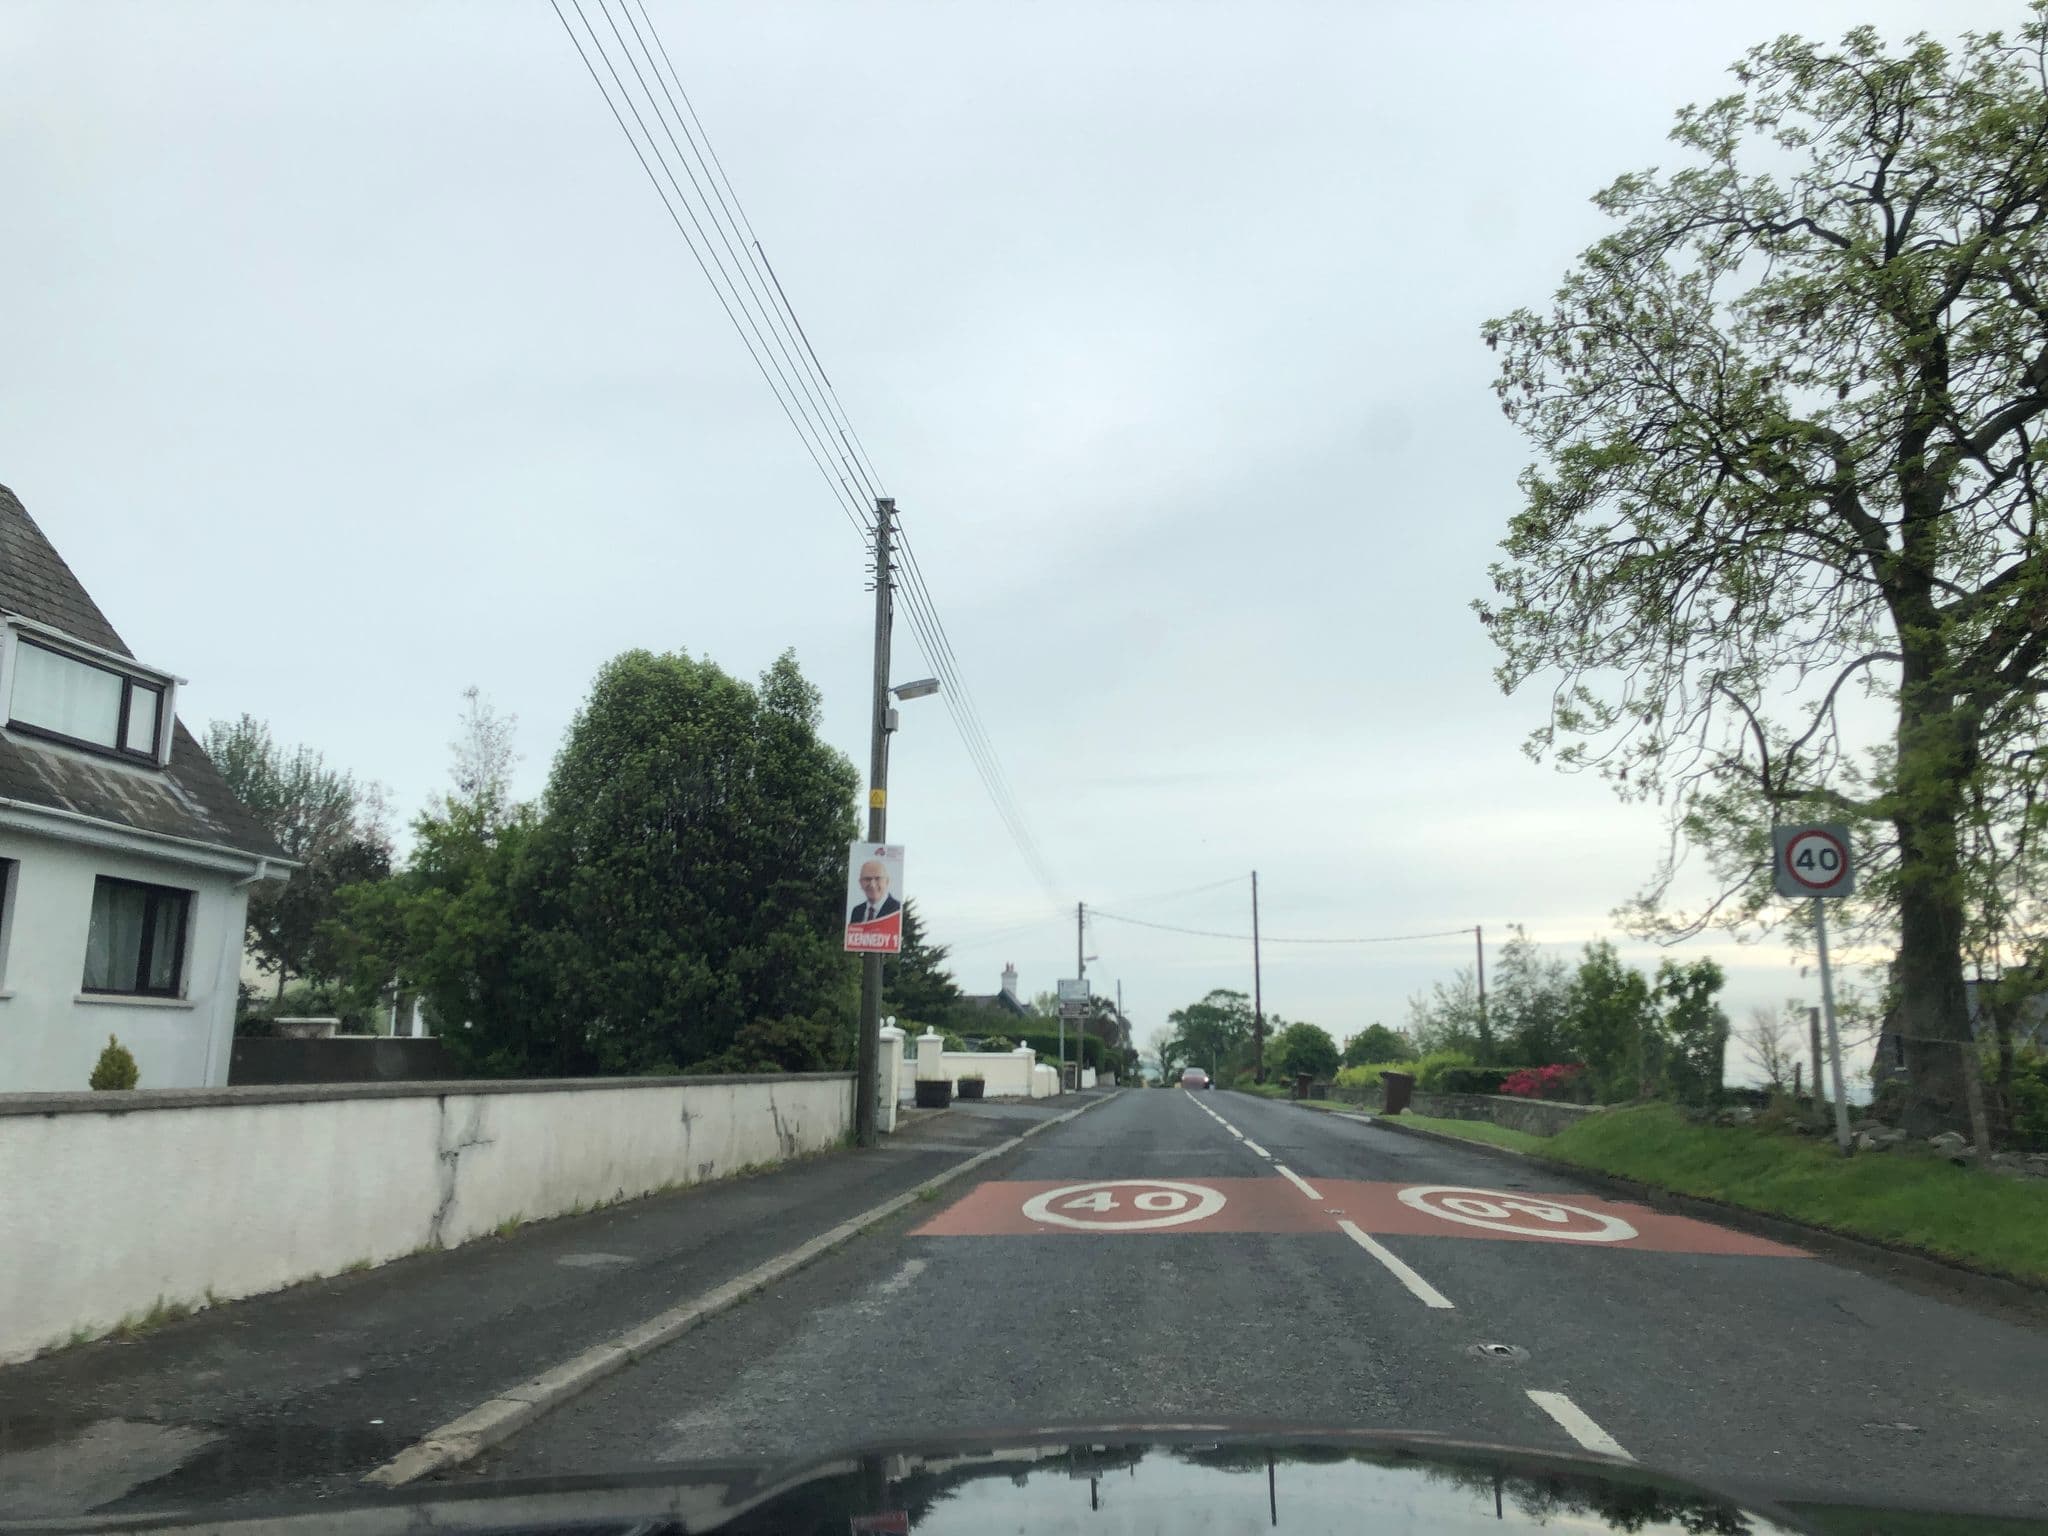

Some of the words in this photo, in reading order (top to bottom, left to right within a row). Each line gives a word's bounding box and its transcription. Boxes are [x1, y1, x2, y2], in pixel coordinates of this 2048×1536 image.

[1796, 848, 1839, 871] 40
[847, 932, 891, 947] KENNEDY
[1062, 1190, 1188, 1212] 40
[1441, 1198, 1570, 1223] 40
